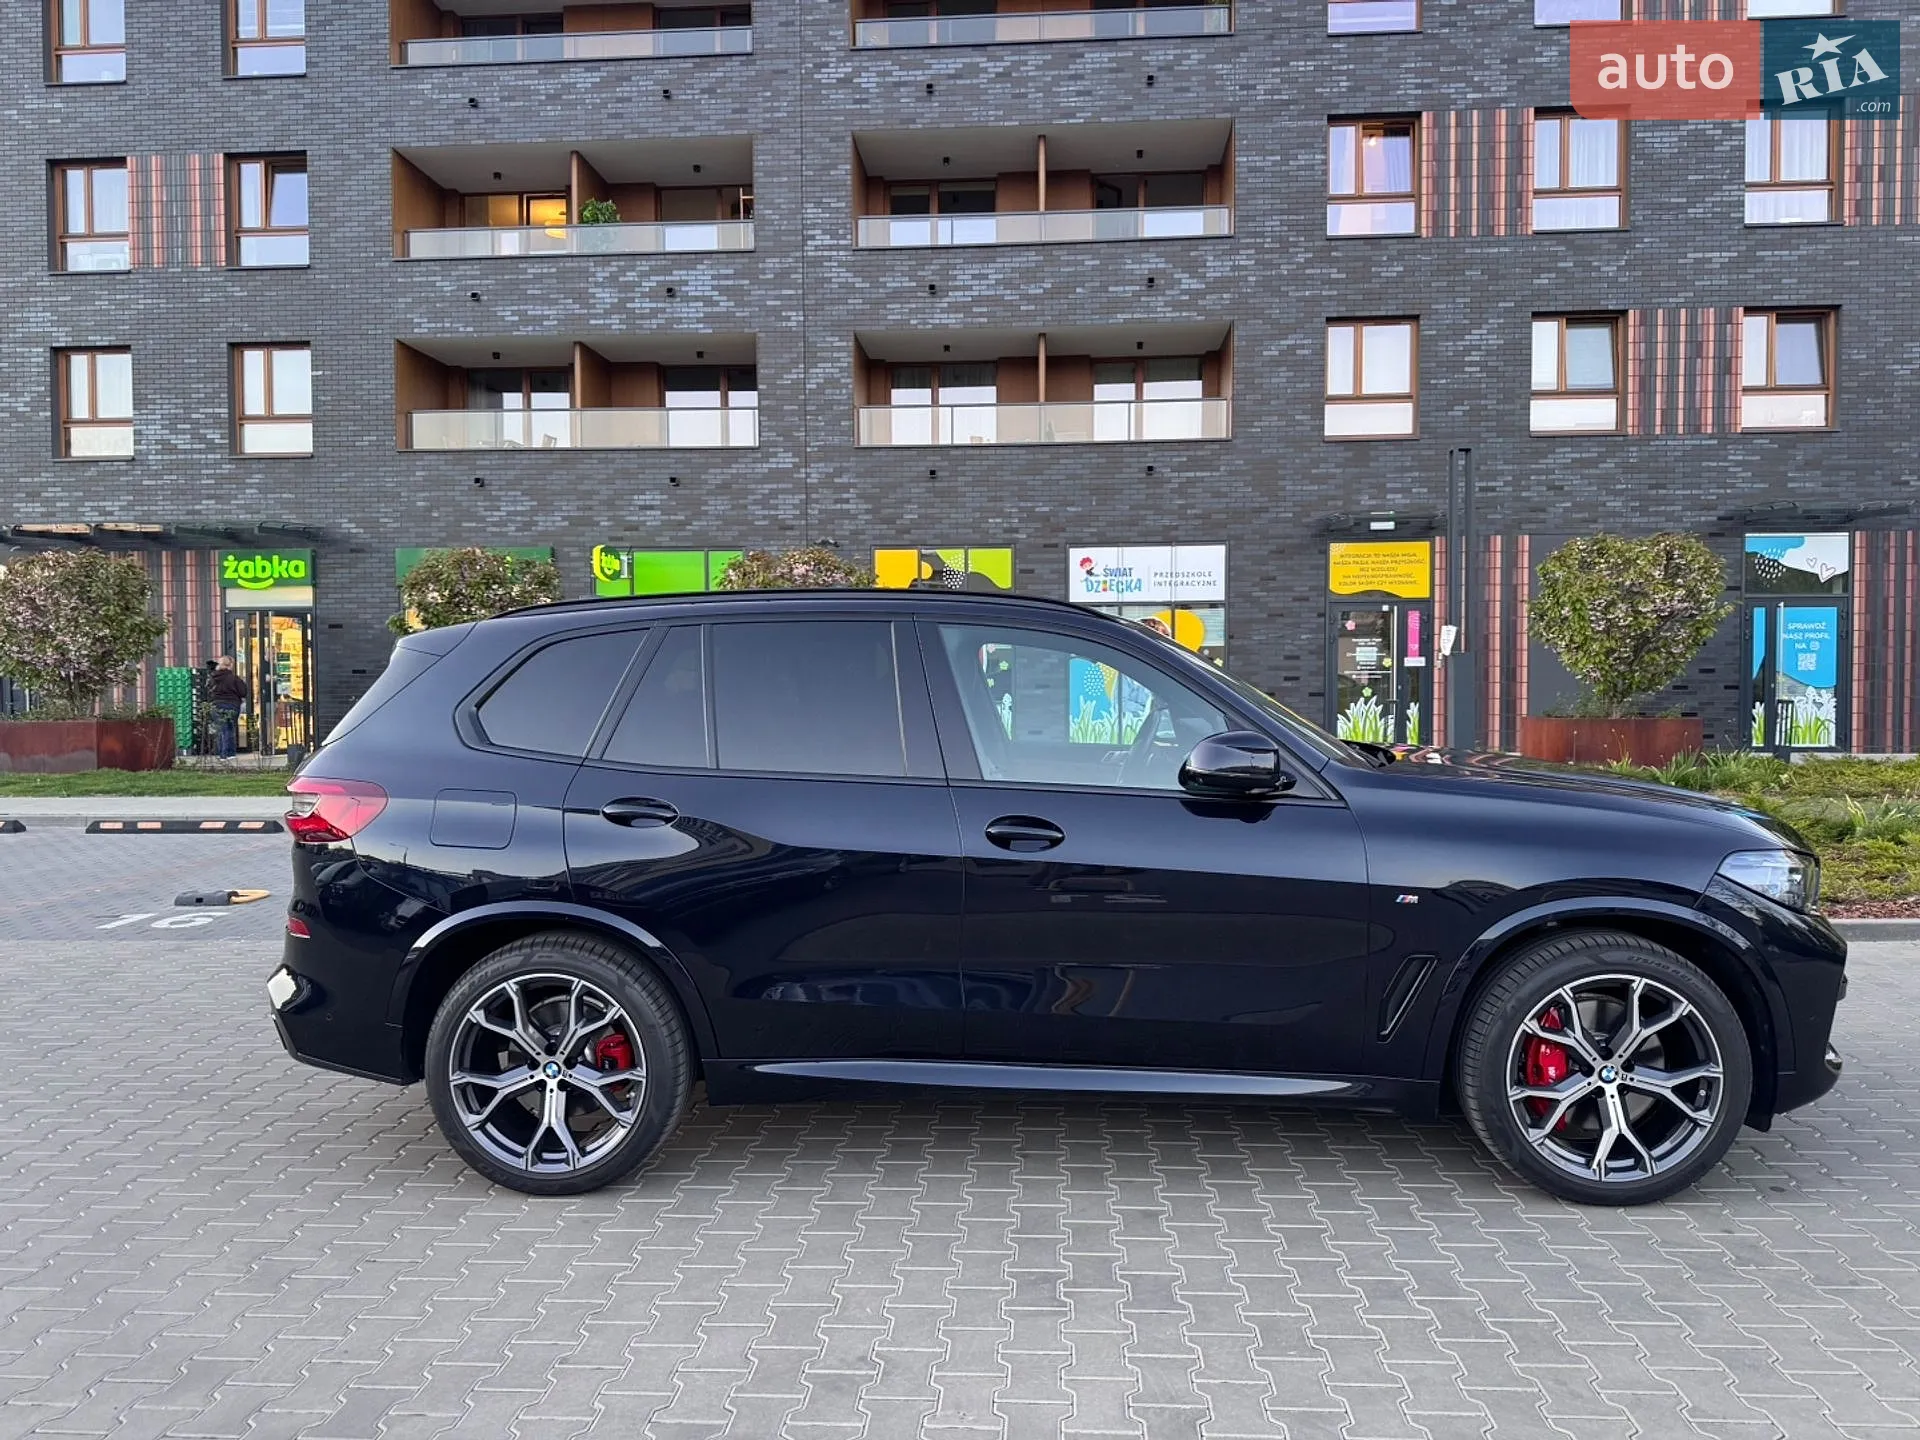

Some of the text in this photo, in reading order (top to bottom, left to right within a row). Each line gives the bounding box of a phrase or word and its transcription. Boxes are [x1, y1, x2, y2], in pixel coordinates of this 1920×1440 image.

[223, 555, 306, 579] żabka
[1103, 565, 1134, 578] ŚWIAT
[1083, 576, 1143, 593] DZIECKA
[1787, 621, 1826, 630] SPRAWDŹ
[1804, 632, 1831, 640] PROFIL
